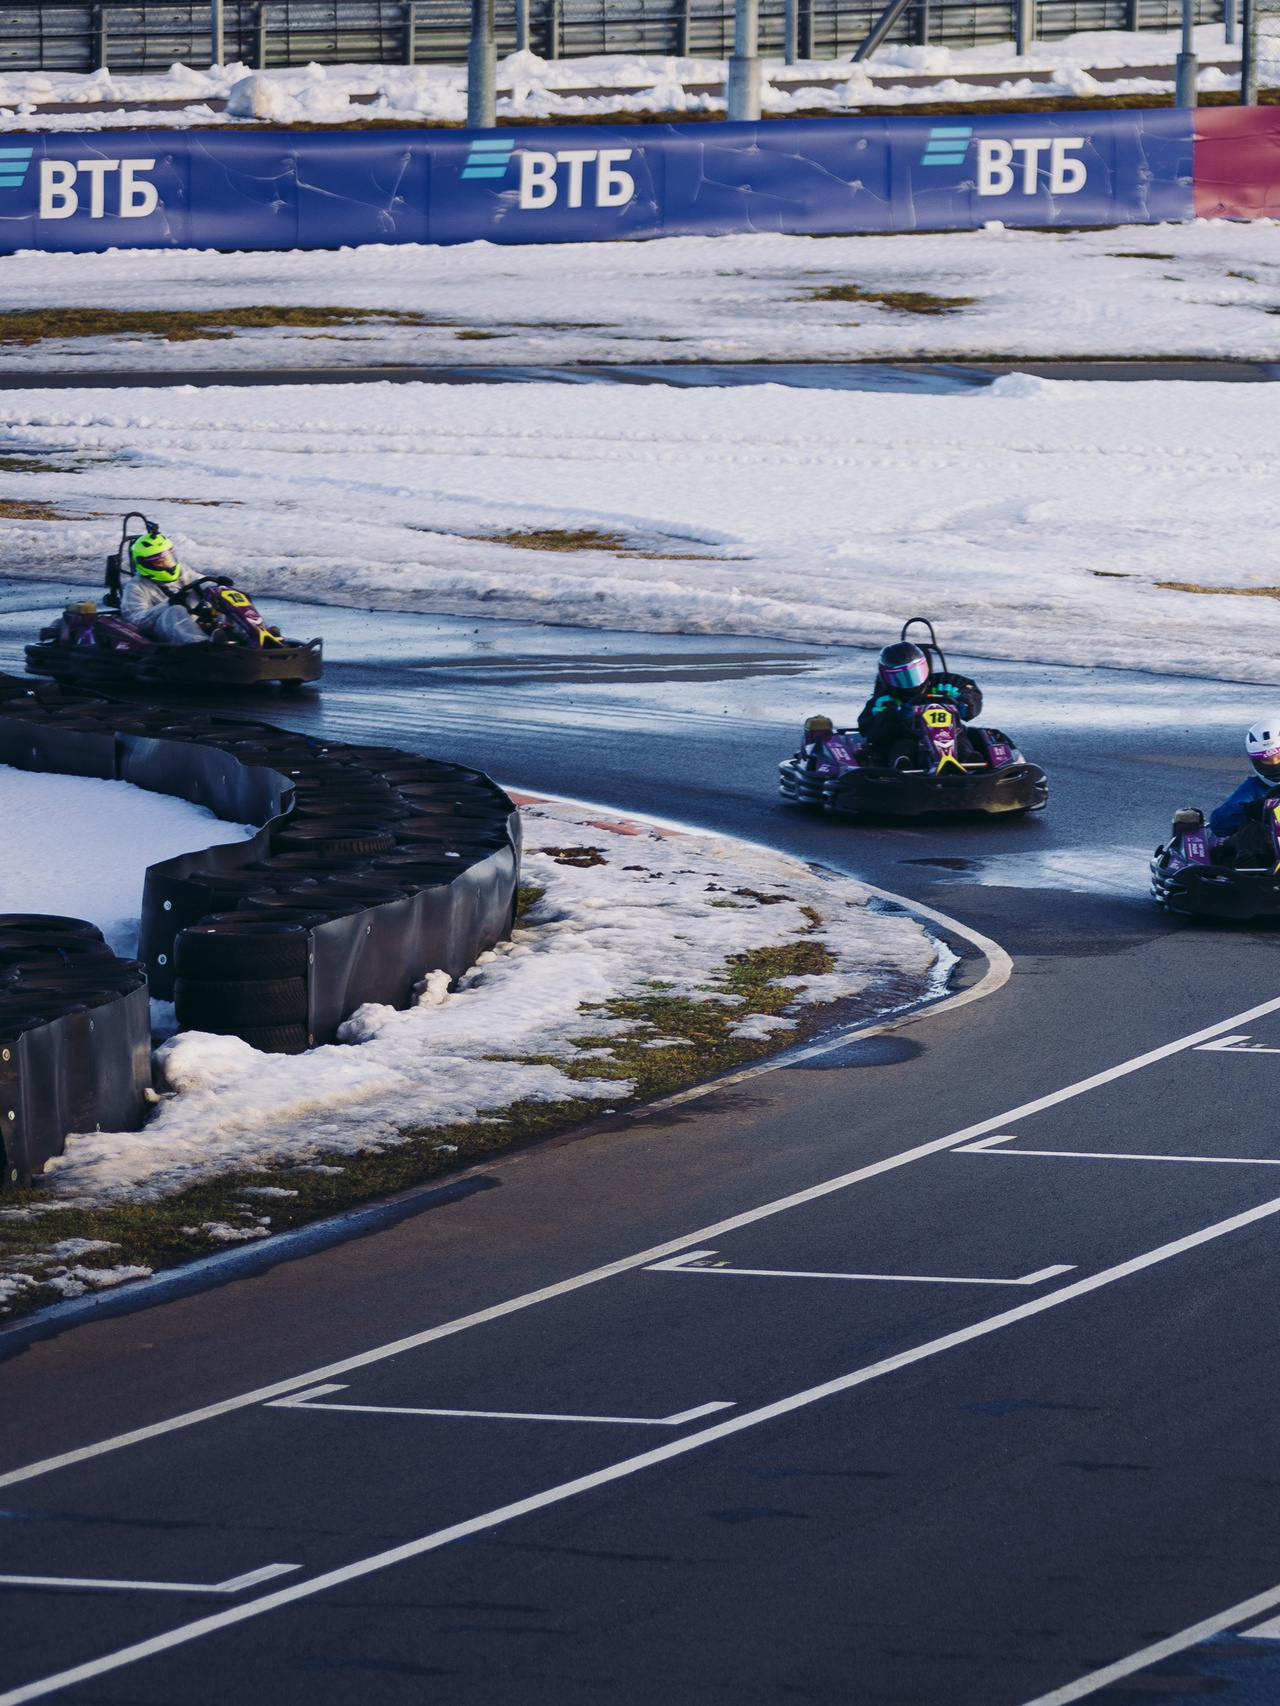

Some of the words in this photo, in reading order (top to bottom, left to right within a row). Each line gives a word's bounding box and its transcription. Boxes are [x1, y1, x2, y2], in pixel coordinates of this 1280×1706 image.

[38, 158, 159, 220] ВТБ
[517, 148, 635, 210] ВТБ
[975, 137, 1087, 196] ВТБ
[228, 592, 246, 604] 19
[929, 712, 947, 724] 18
